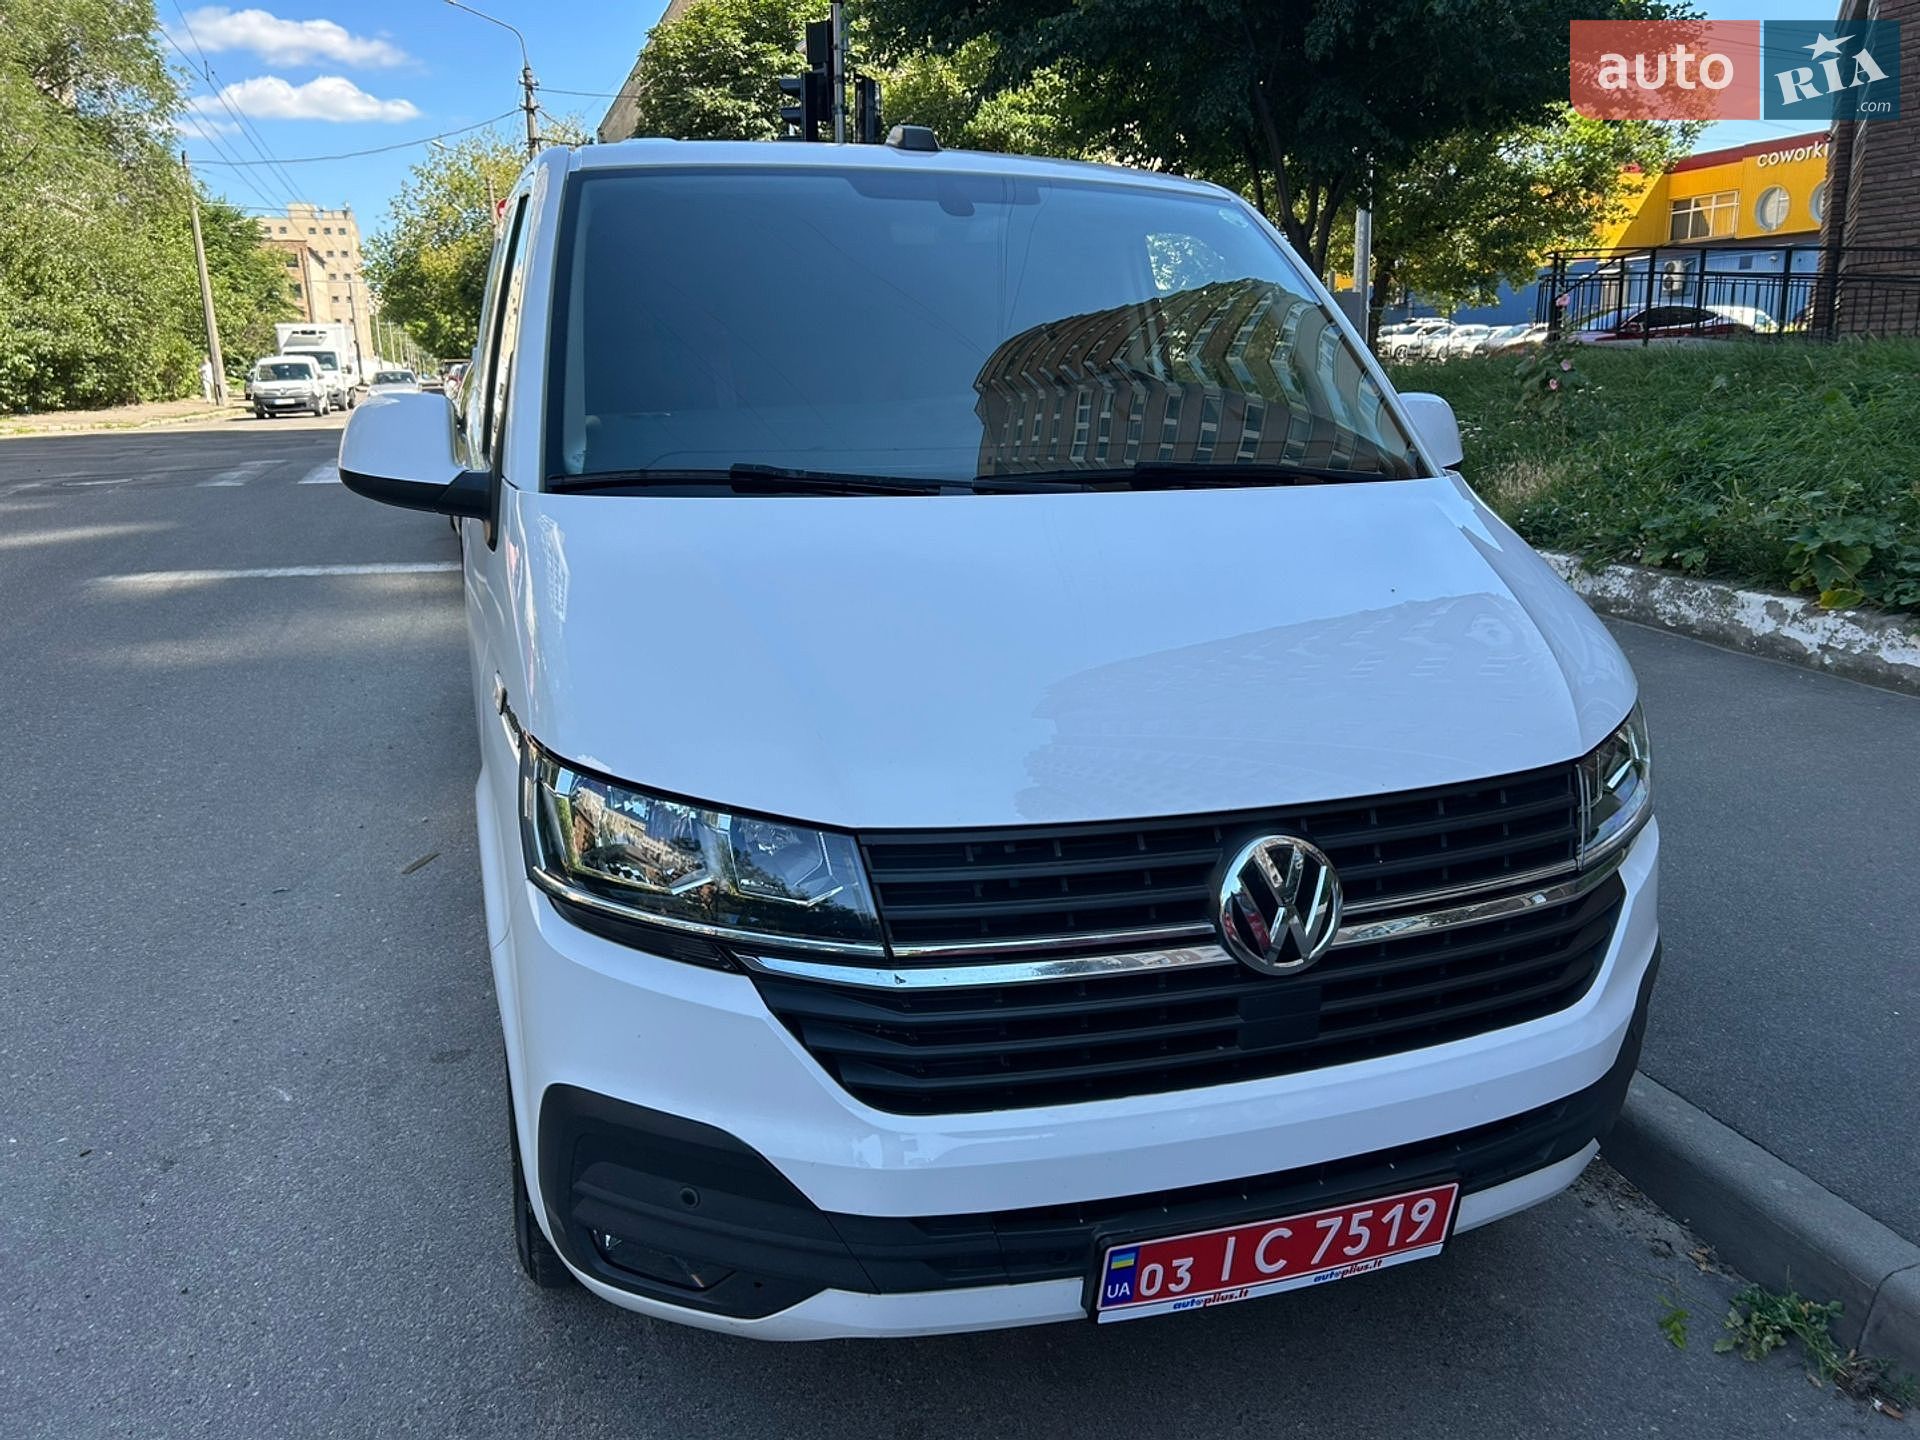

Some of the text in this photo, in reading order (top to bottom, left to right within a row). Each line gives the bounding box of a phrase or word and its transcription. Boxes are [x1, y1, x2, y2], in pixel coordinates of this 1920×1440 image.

[1107, 1198, 1436, 1299] UA 03 IC 7519
